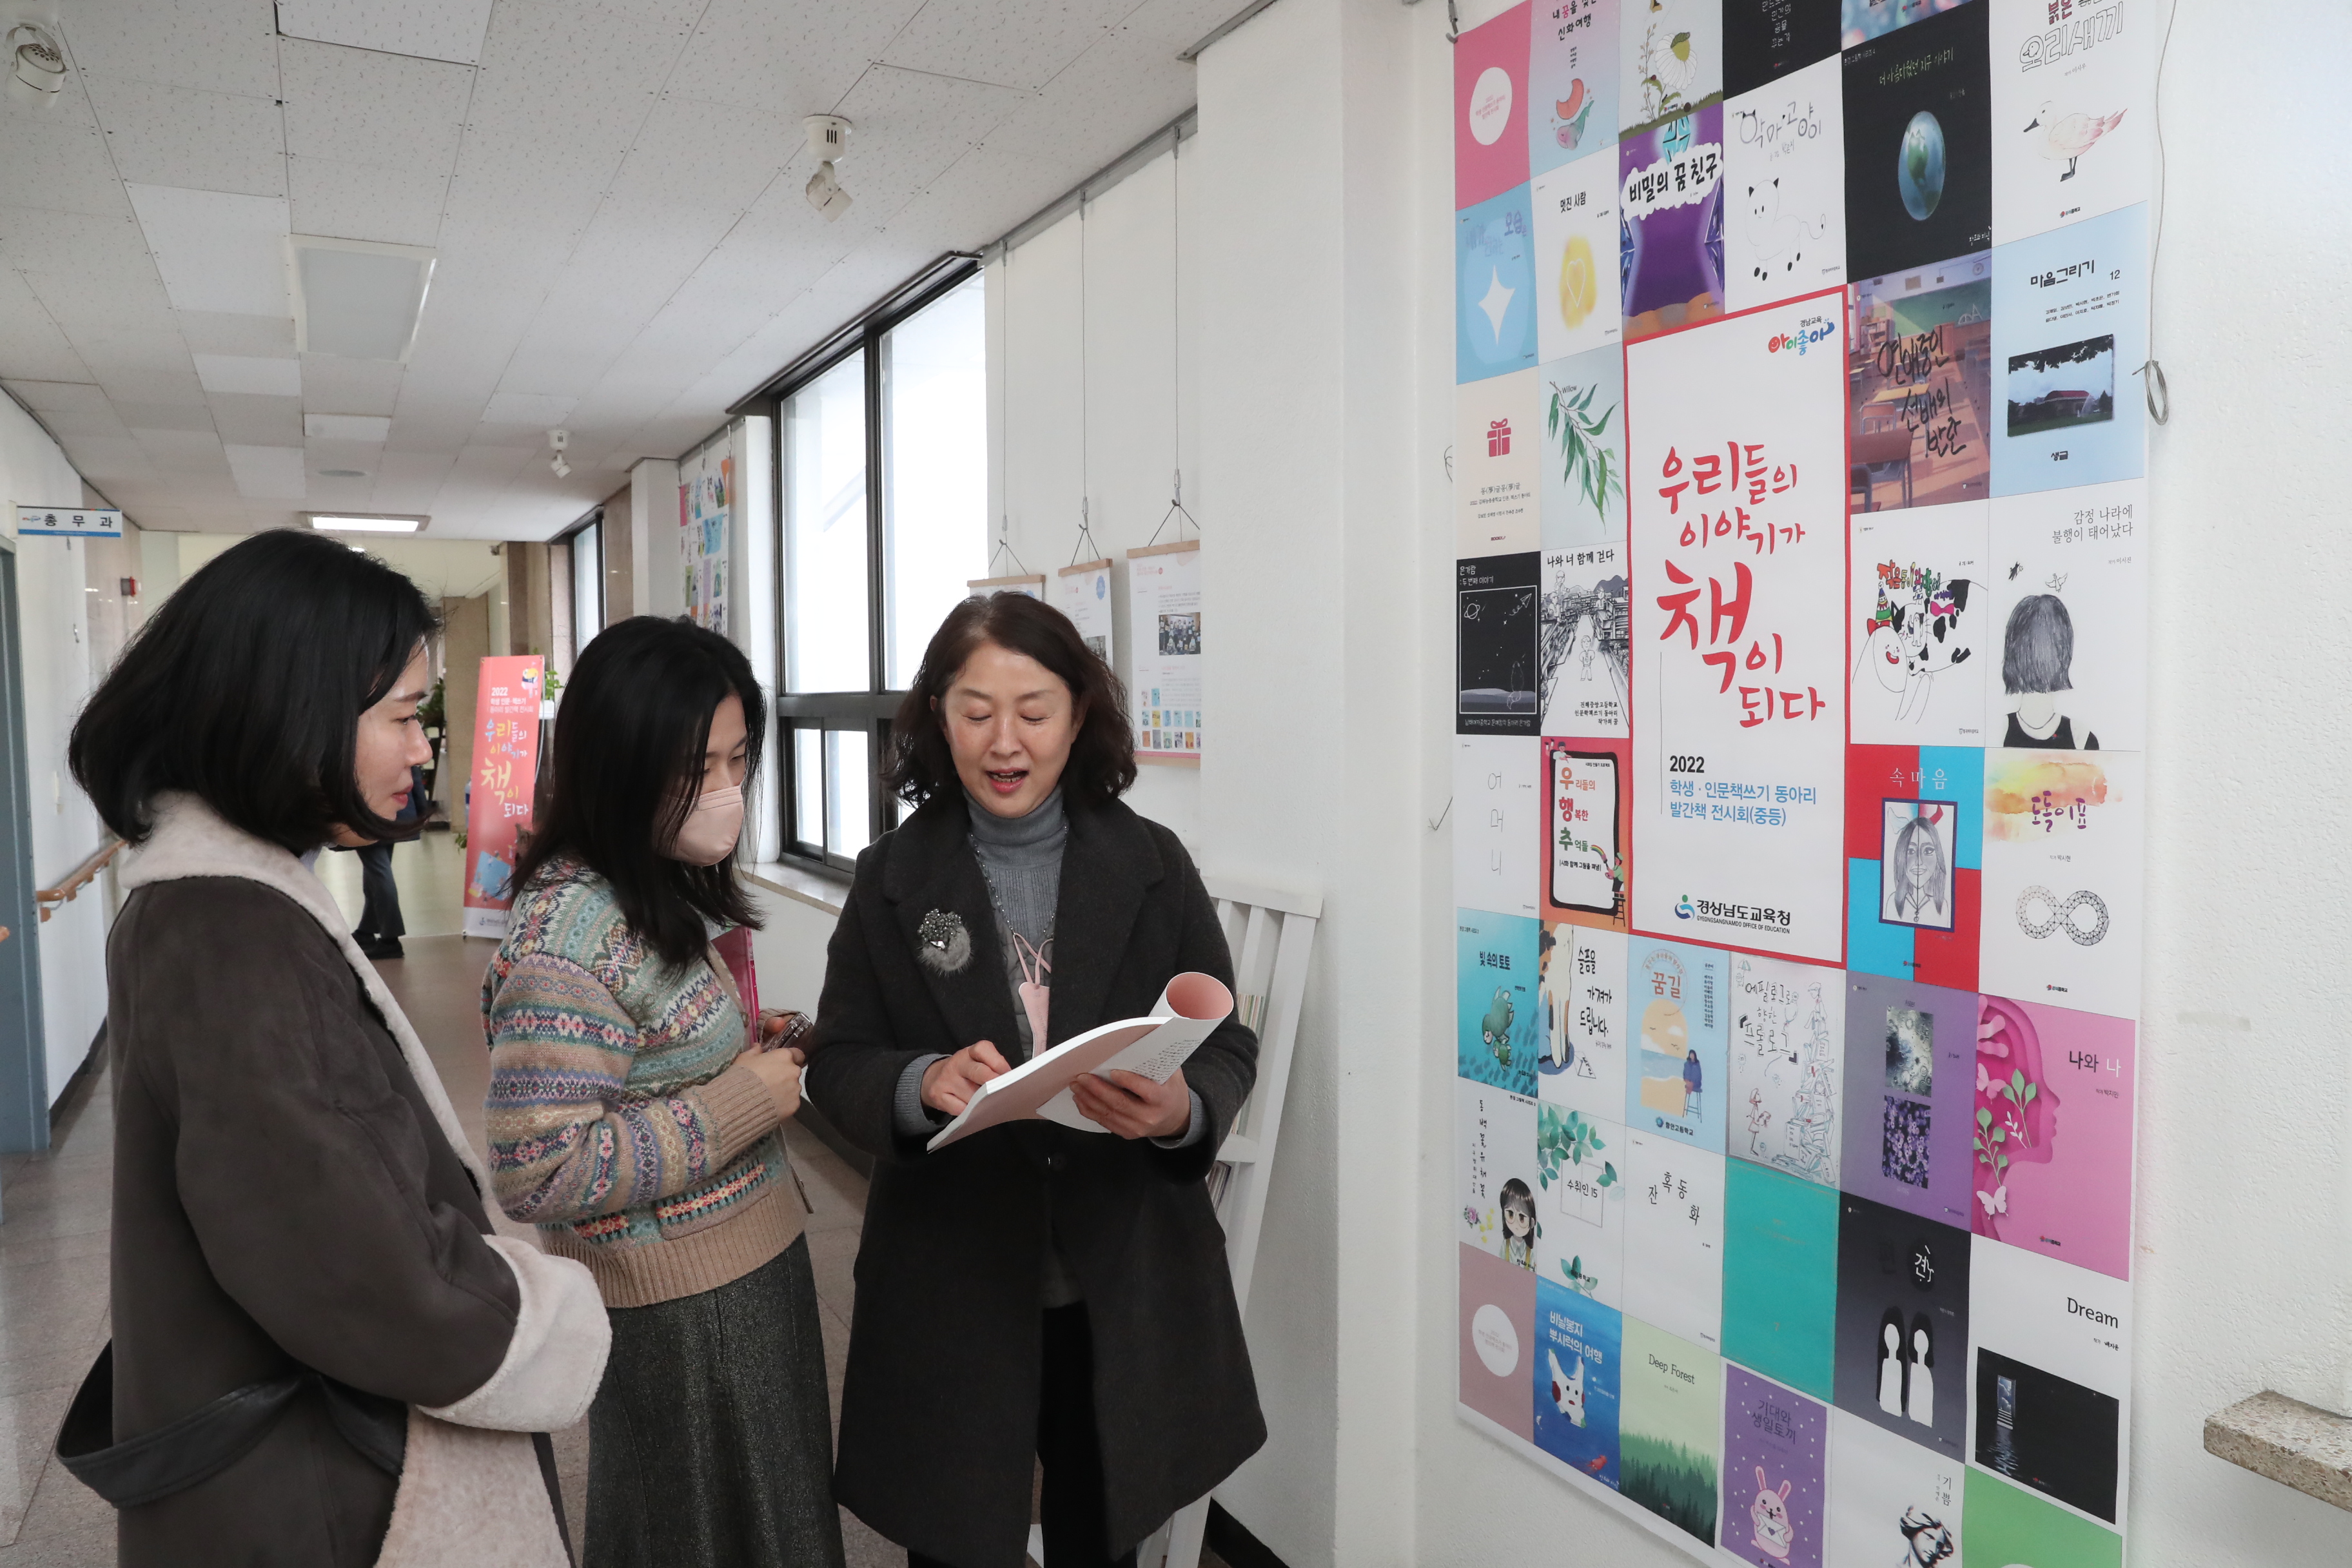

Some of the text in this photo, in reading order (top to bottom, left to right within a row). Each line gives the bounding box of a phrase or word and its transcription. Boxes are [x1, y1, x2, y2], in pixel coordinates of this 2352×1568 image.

[1553, 8, 1560, 19] 내
[1562, 1, 1578, 19] 꿈을
[1771, 3, 1791, 21] 인간의
[2019, 1, 2123, 73] 오리새끼
[1879, 47, 1954, 86] 더 아름다웠던 지구 이야기
[1629, 153, 1718, 203] 비밀의 꿈 친구
[1560, 191, 1587, 213] 멋진 사람
[2030, 259, 2121, 288] 마음그리기 12
[1799, 315, 1823, 328] 경남교육
[1768, 321, 1836, 356] 아이좋아
[1562, 385, 1578, 394] Willow
[2051, 450, 2069, 461] 생글
[1658, 441, 1797, 514] 우리들의
[44, 514, 113, 528] 총무과
[2073, 504, 2133, 525] 감정 나라에
[1680, 506, 1805, 554] 이야기가
[2052, 522, 2133, 544] 불행이 태어났다
[1460, 565, 1476, 576] 은가람
[1547, 549, 1614, 568] 나와 너 함께 걷다
[1479, 575, 1494, 585] 이야기
[1656, 559, 1783, 694] 책이
[491, 687, 509, 696] 2022
[1738, 686, 1826, 728] 되다
[485, 718, 527, 742] 우리들의
[490, 742, 527, 759] 이야기가
[1670, 755, 1705, 773] 2022
[481, 757, 519, 805] 책이
[1670, 779, 1816, 805] 학생 인문책쓰기 동아리
[504, 802, 529, 818] 되다
[1670, 802, 1787, 827] 발간책 전시회(중등)
[1696, 899, 1791, 926] 경상남도교육청
[1696, 915, 1742, 928] GYEONGSANGNAMDO
[1743, 921, 1757, 930] OFFICE
[1764, 925, 1790, 934] EDUCATION
[1480, 951, 1511, 970] 빛 속의 토토
[1578, 946, 1596, 974] 슬픔을
[1587, 986, 1612, 1004] 가져가
[1651, 972, 1681, 999] 꿈길
[1745, 980, 1791, 1005] 에필로그로
[1580, 1006, 1609, 1037] 드립니다.
[1757, 1006, 1777, 1024] 향한
[2069, 1050, 2121, 1078] 나와 나
[1567, 1179, 1598, 1198] 수취인 15
[1550, 1311, 1583, 1337] 비닐봉지
[2067, 1297, 2119, 1328] Dream
[1549, 1328, 1603, 1364] 뿌시럭의 여행
[1649, 1353, 1695, 1385] Deep Forest
[1758, 1400, 1792, 1427] 기대와
[1751, 1411, 1796, 1445] 생일토끼
[1942, 1476, 1952, 1507] 기쁨
